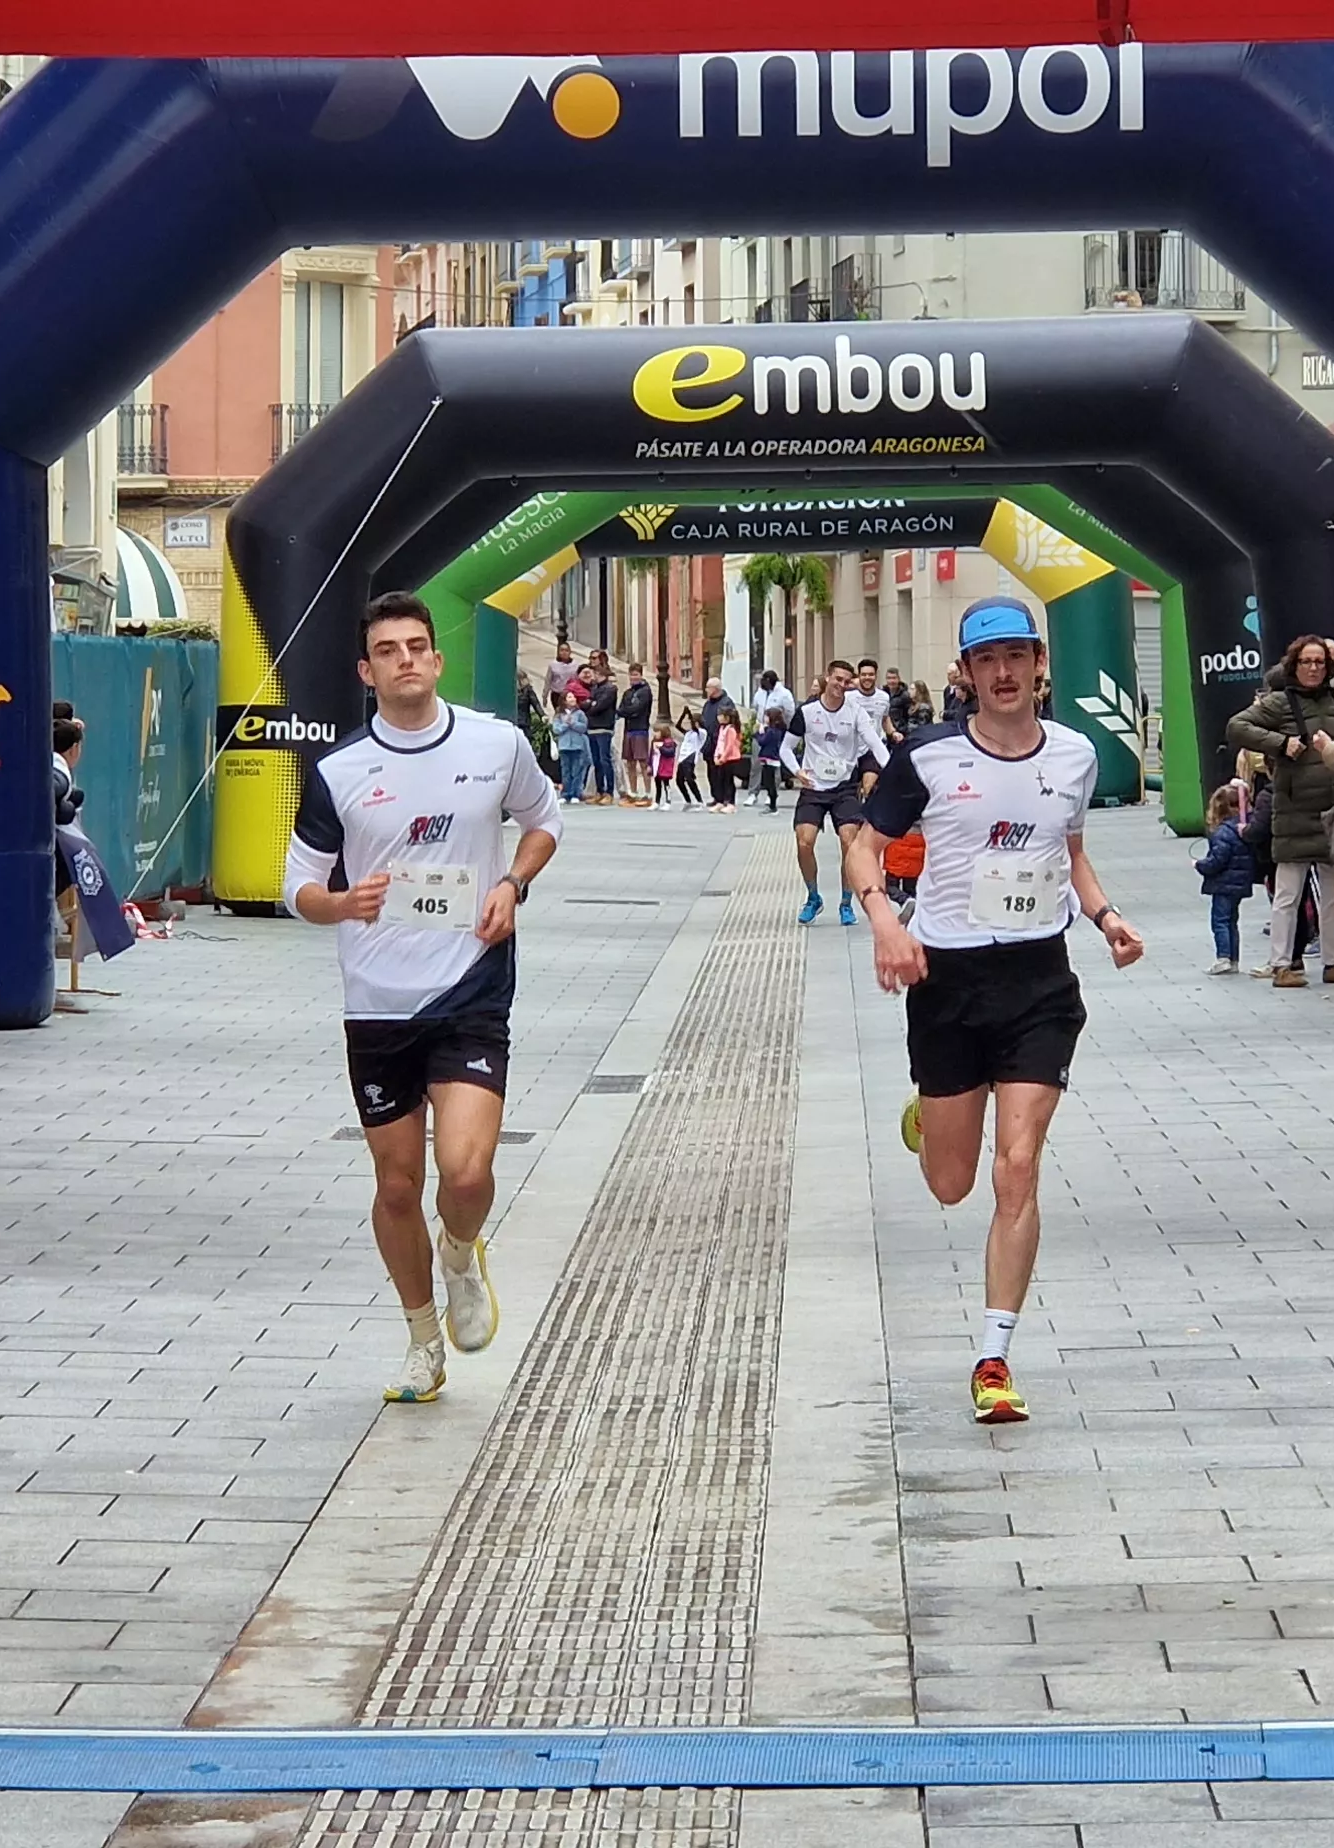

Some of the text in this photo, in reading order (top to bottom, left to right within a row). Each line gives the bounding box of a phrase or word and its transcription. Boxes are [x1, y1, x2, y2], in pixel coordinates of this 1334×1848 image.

[679, 41, 1144, 167] mupol
[632, 334, 987, 422] embou
[635, 436, 985, 458] PÁSATE A LA OPERADORA ARAGONESA
[670, 512, 954, 540] CAJA RURAL DE ARAGÓN
[235, 713, 336, 742] embou
[412, 897, 448, 915] 405
[1002, 895, 1036, 913] 189
